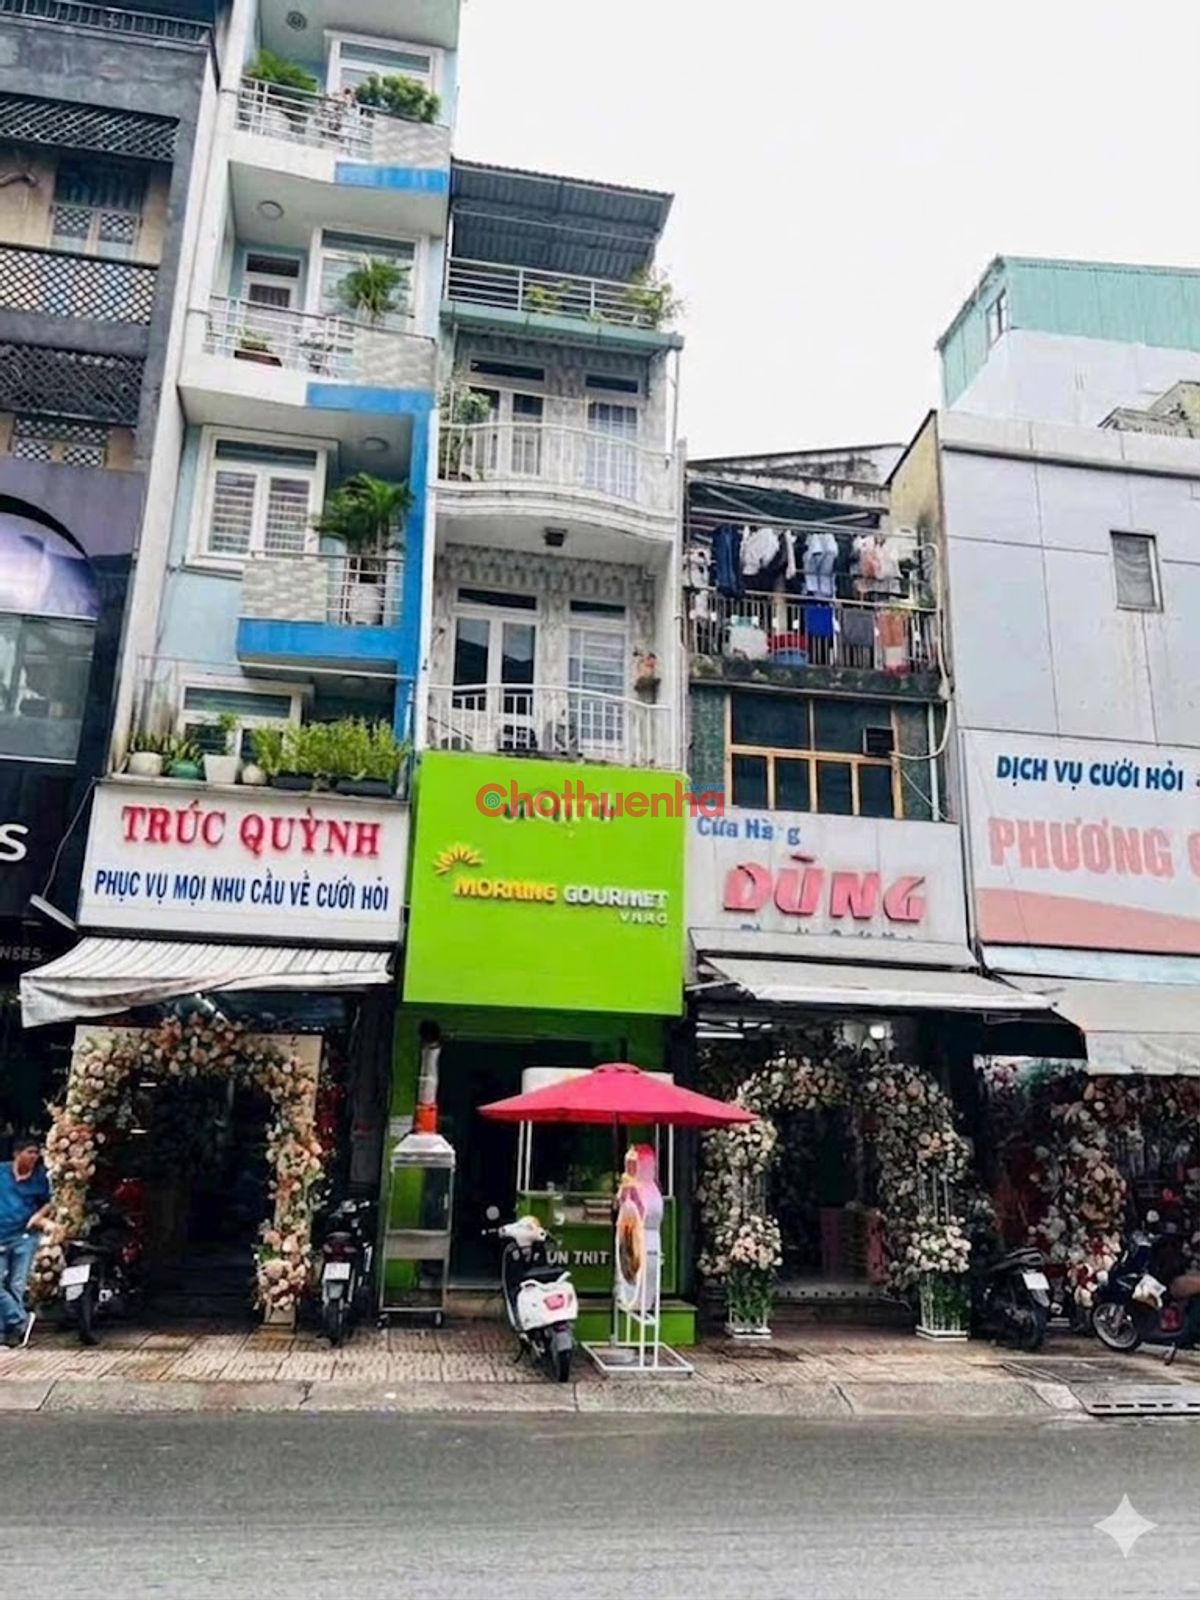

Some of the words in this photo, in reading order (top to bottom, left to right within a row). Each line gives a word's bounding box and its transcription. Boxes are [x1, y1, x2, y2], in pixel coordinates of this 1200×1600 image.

[996, 756, 1048, 786] DỊCH
[1054, 760, 1083, 790] VỤ
[1089, 758, 1139, 788] CƯỚI
[1145, 761, 1183, 791] HỎI
[121, 800, 226, 847] TRÚC
[239, 807, 381, 858] QUỲNH
[988, 817, 1175, 878] PHƯƠNG
[94, 869, 141, 902] PHỤC
[145, 872, 169, 905] VỤ
[173, 874, 206, 906] MỌI
[210, 876, 246, 902] NHU
[250, 867, 285, 905] CẦU
[290, 869, 311, 906] VỀ
[316, 874, 356, 909] CƯỚI
[361, 876, 389, 911] HỎI
[454, 877, 558, 903] MORNING
[563, 884, 668, 909] GOURMET
